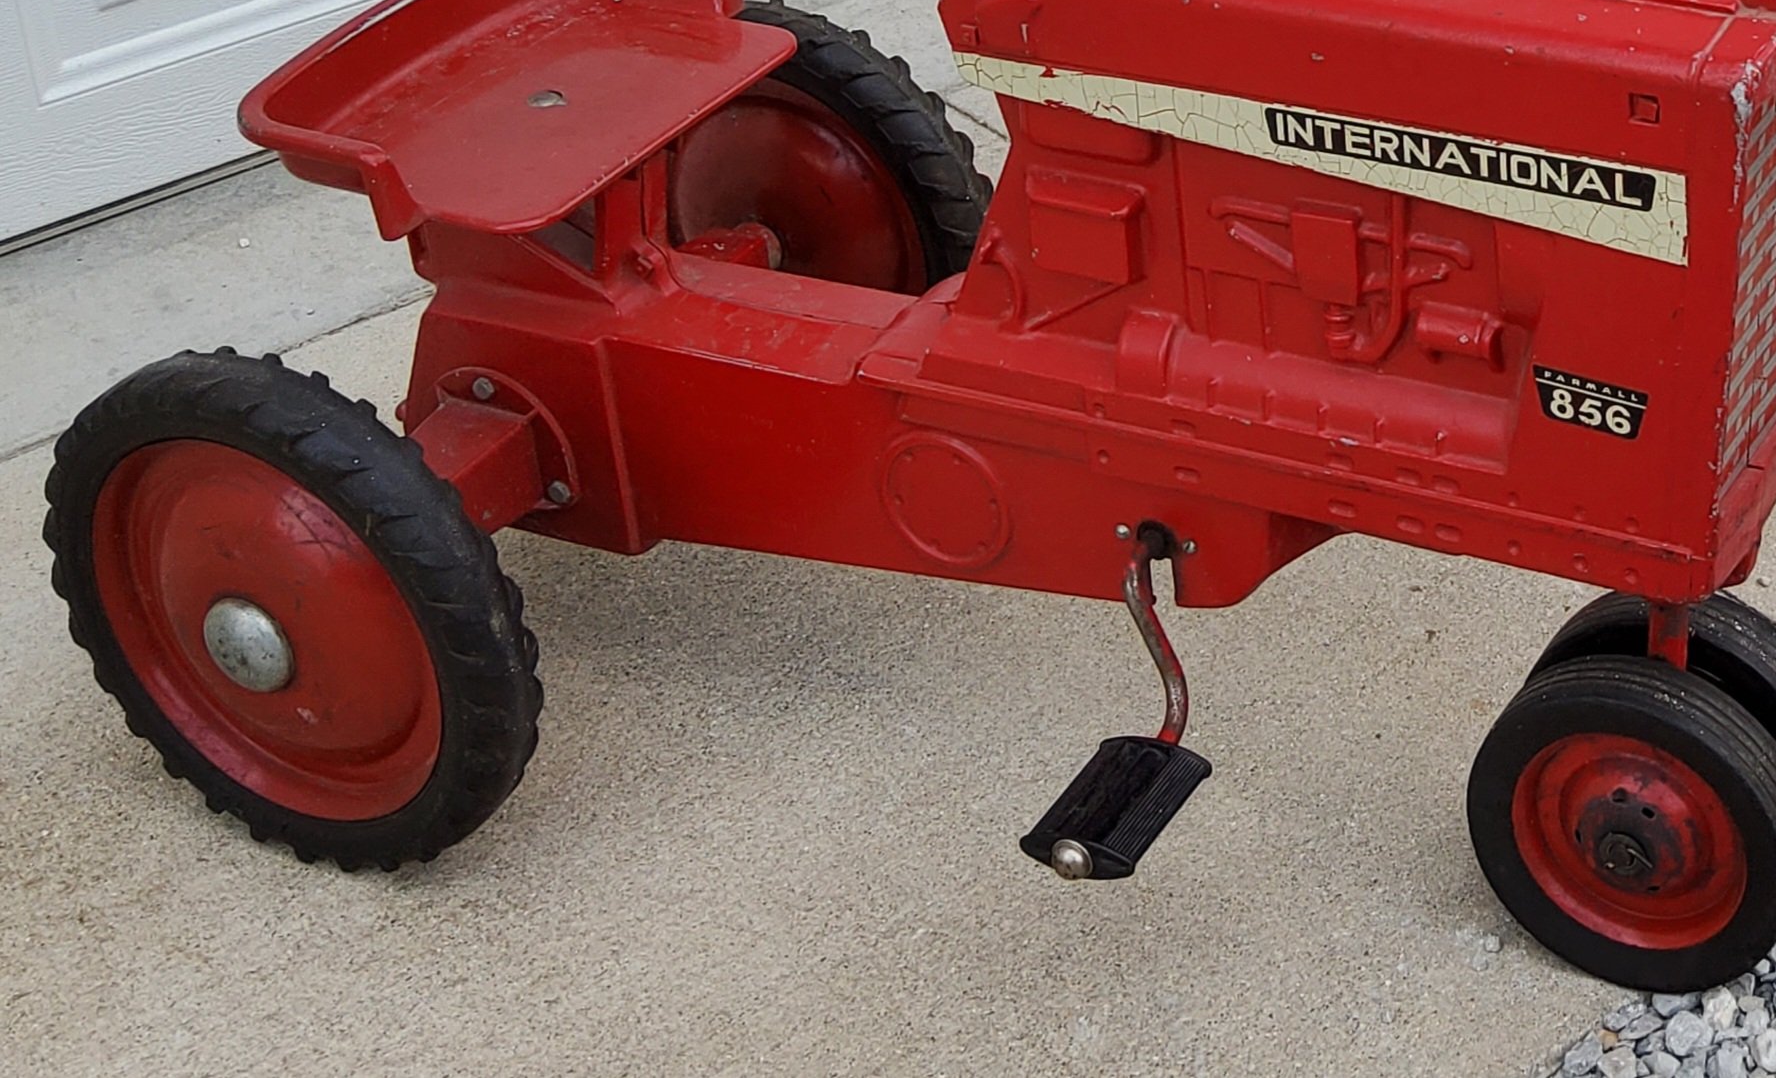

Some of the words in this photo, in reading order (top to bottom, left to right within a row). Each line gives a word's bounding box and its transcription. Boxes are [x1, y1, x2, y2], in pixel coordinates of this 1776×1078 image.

[1275, 112, 1643, 207] INTERNATIONAL
[1543, 370, 1640, 402] FARMALL
[1549, 388, 1632, 435] 856
